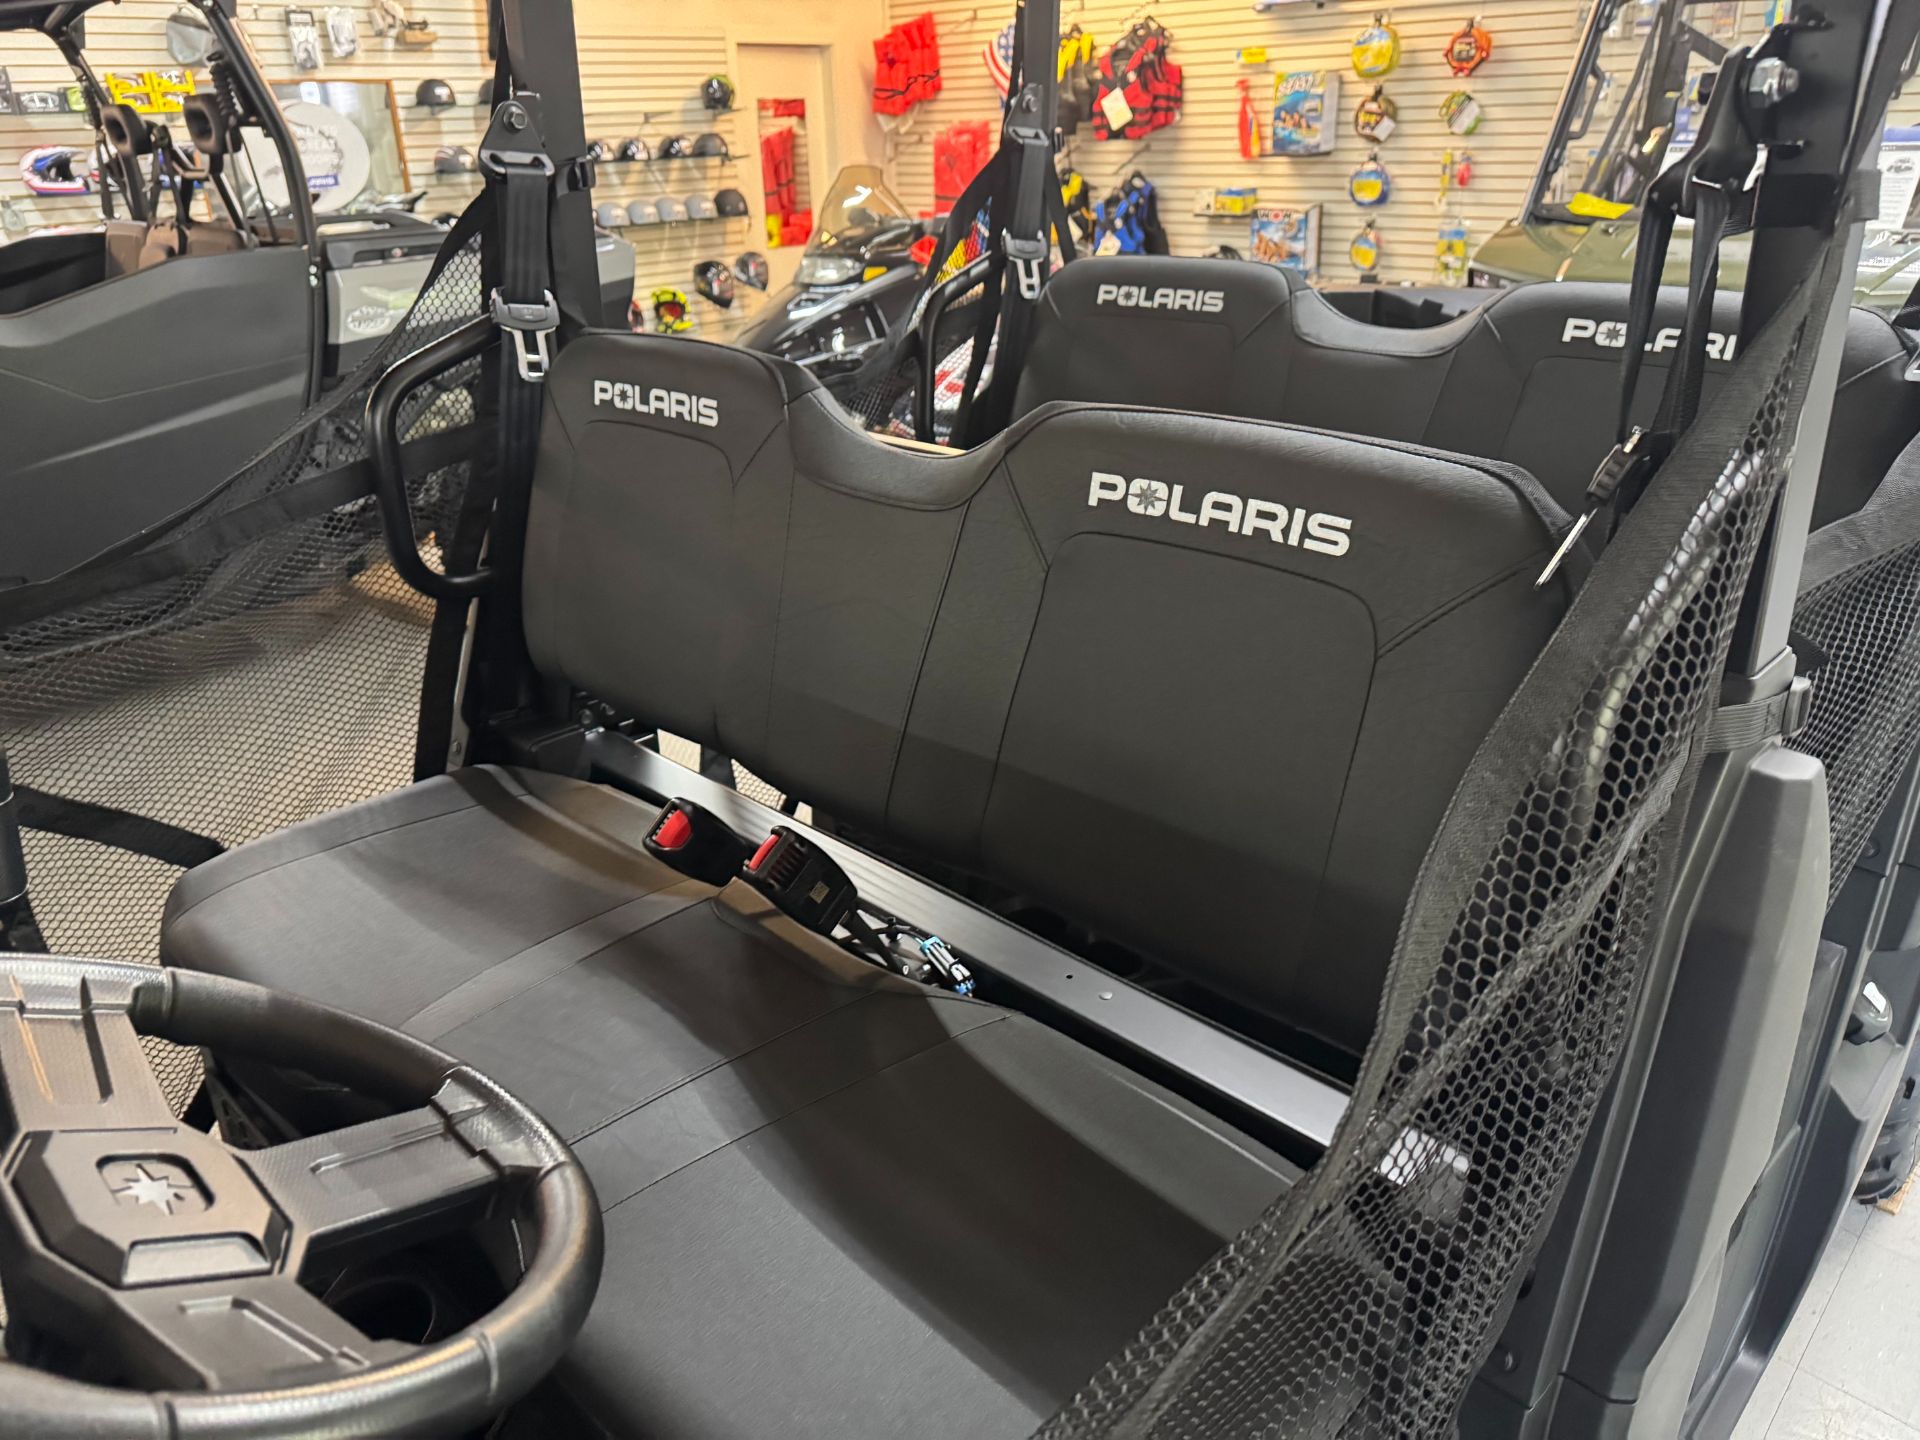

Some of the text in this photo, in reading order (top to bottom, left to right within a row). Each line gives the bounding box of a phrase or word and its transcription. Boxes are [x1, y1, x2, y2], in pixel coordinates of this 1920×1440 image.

[1096, 284, 1225, 313] POLARIS
[1561, 317, 1738, 361] POARI
[593, 379, 719, 428] POLARIS
[1087, 471, 1353, 557] POLARIS
